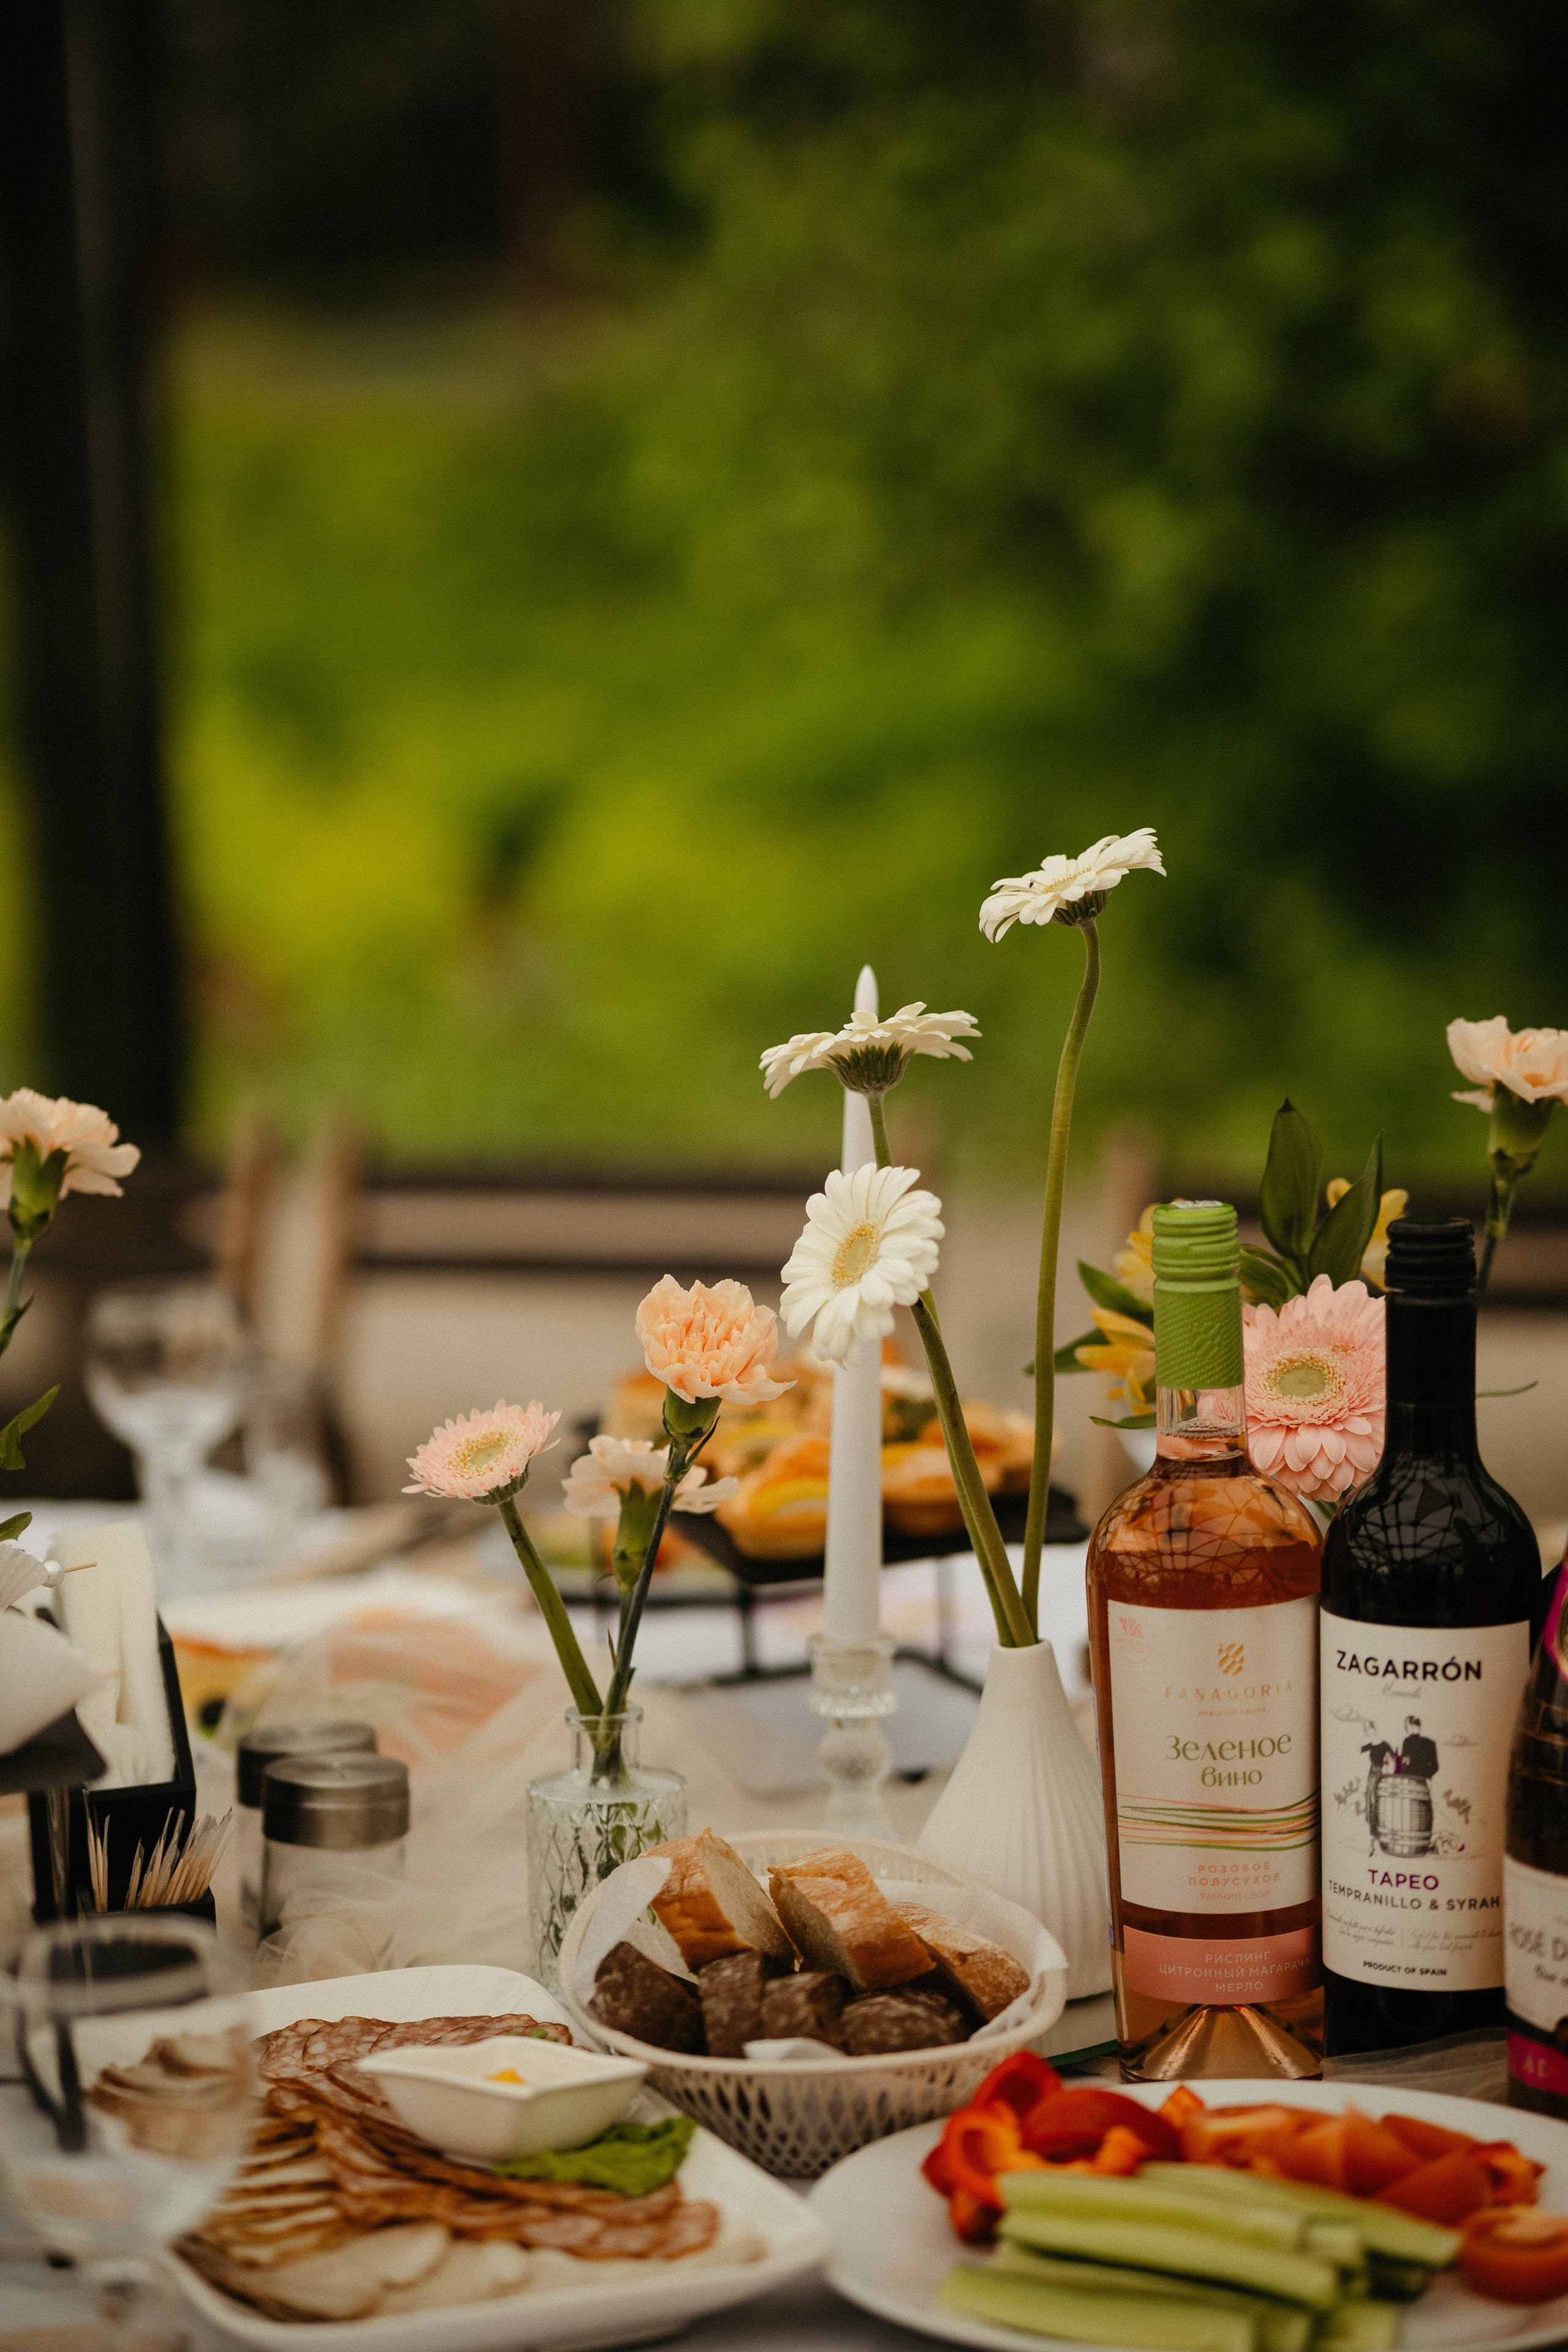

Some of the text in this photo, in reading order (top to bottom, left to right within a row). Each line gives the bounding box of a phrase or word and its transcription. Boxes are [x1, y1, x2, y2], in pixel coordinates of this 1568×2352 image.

[1336, 1649, 1483, 1682] ZAGARRÓN
[1164, 1681, 1292, 1701] FANAGORIA
[1165, 1734, 1292, 1762] Зеленое
[1197, 1861, 1271, 1874] РОЗОВОЕ
[1188, 1872, 1280, 1887] ПОЛУСУХОЕ
[1368, 1869, 1439, 1891] TAPEO
[1328, 1879, 1501, 1911] TEMPRANILLO & SYRAH
[1205, 1950, 1271, 1964] РИСЛИНГ
[1159, 1957, 1311, 1978] ЦИТРОННЫЙ МАГАРАЧА
[1363, 1960, 1401, 1973] PRODUCT
[1420, 1967, 1447, 1976] SPAIN
[1215, 1981, 1264, 1993] МЕРЛО
